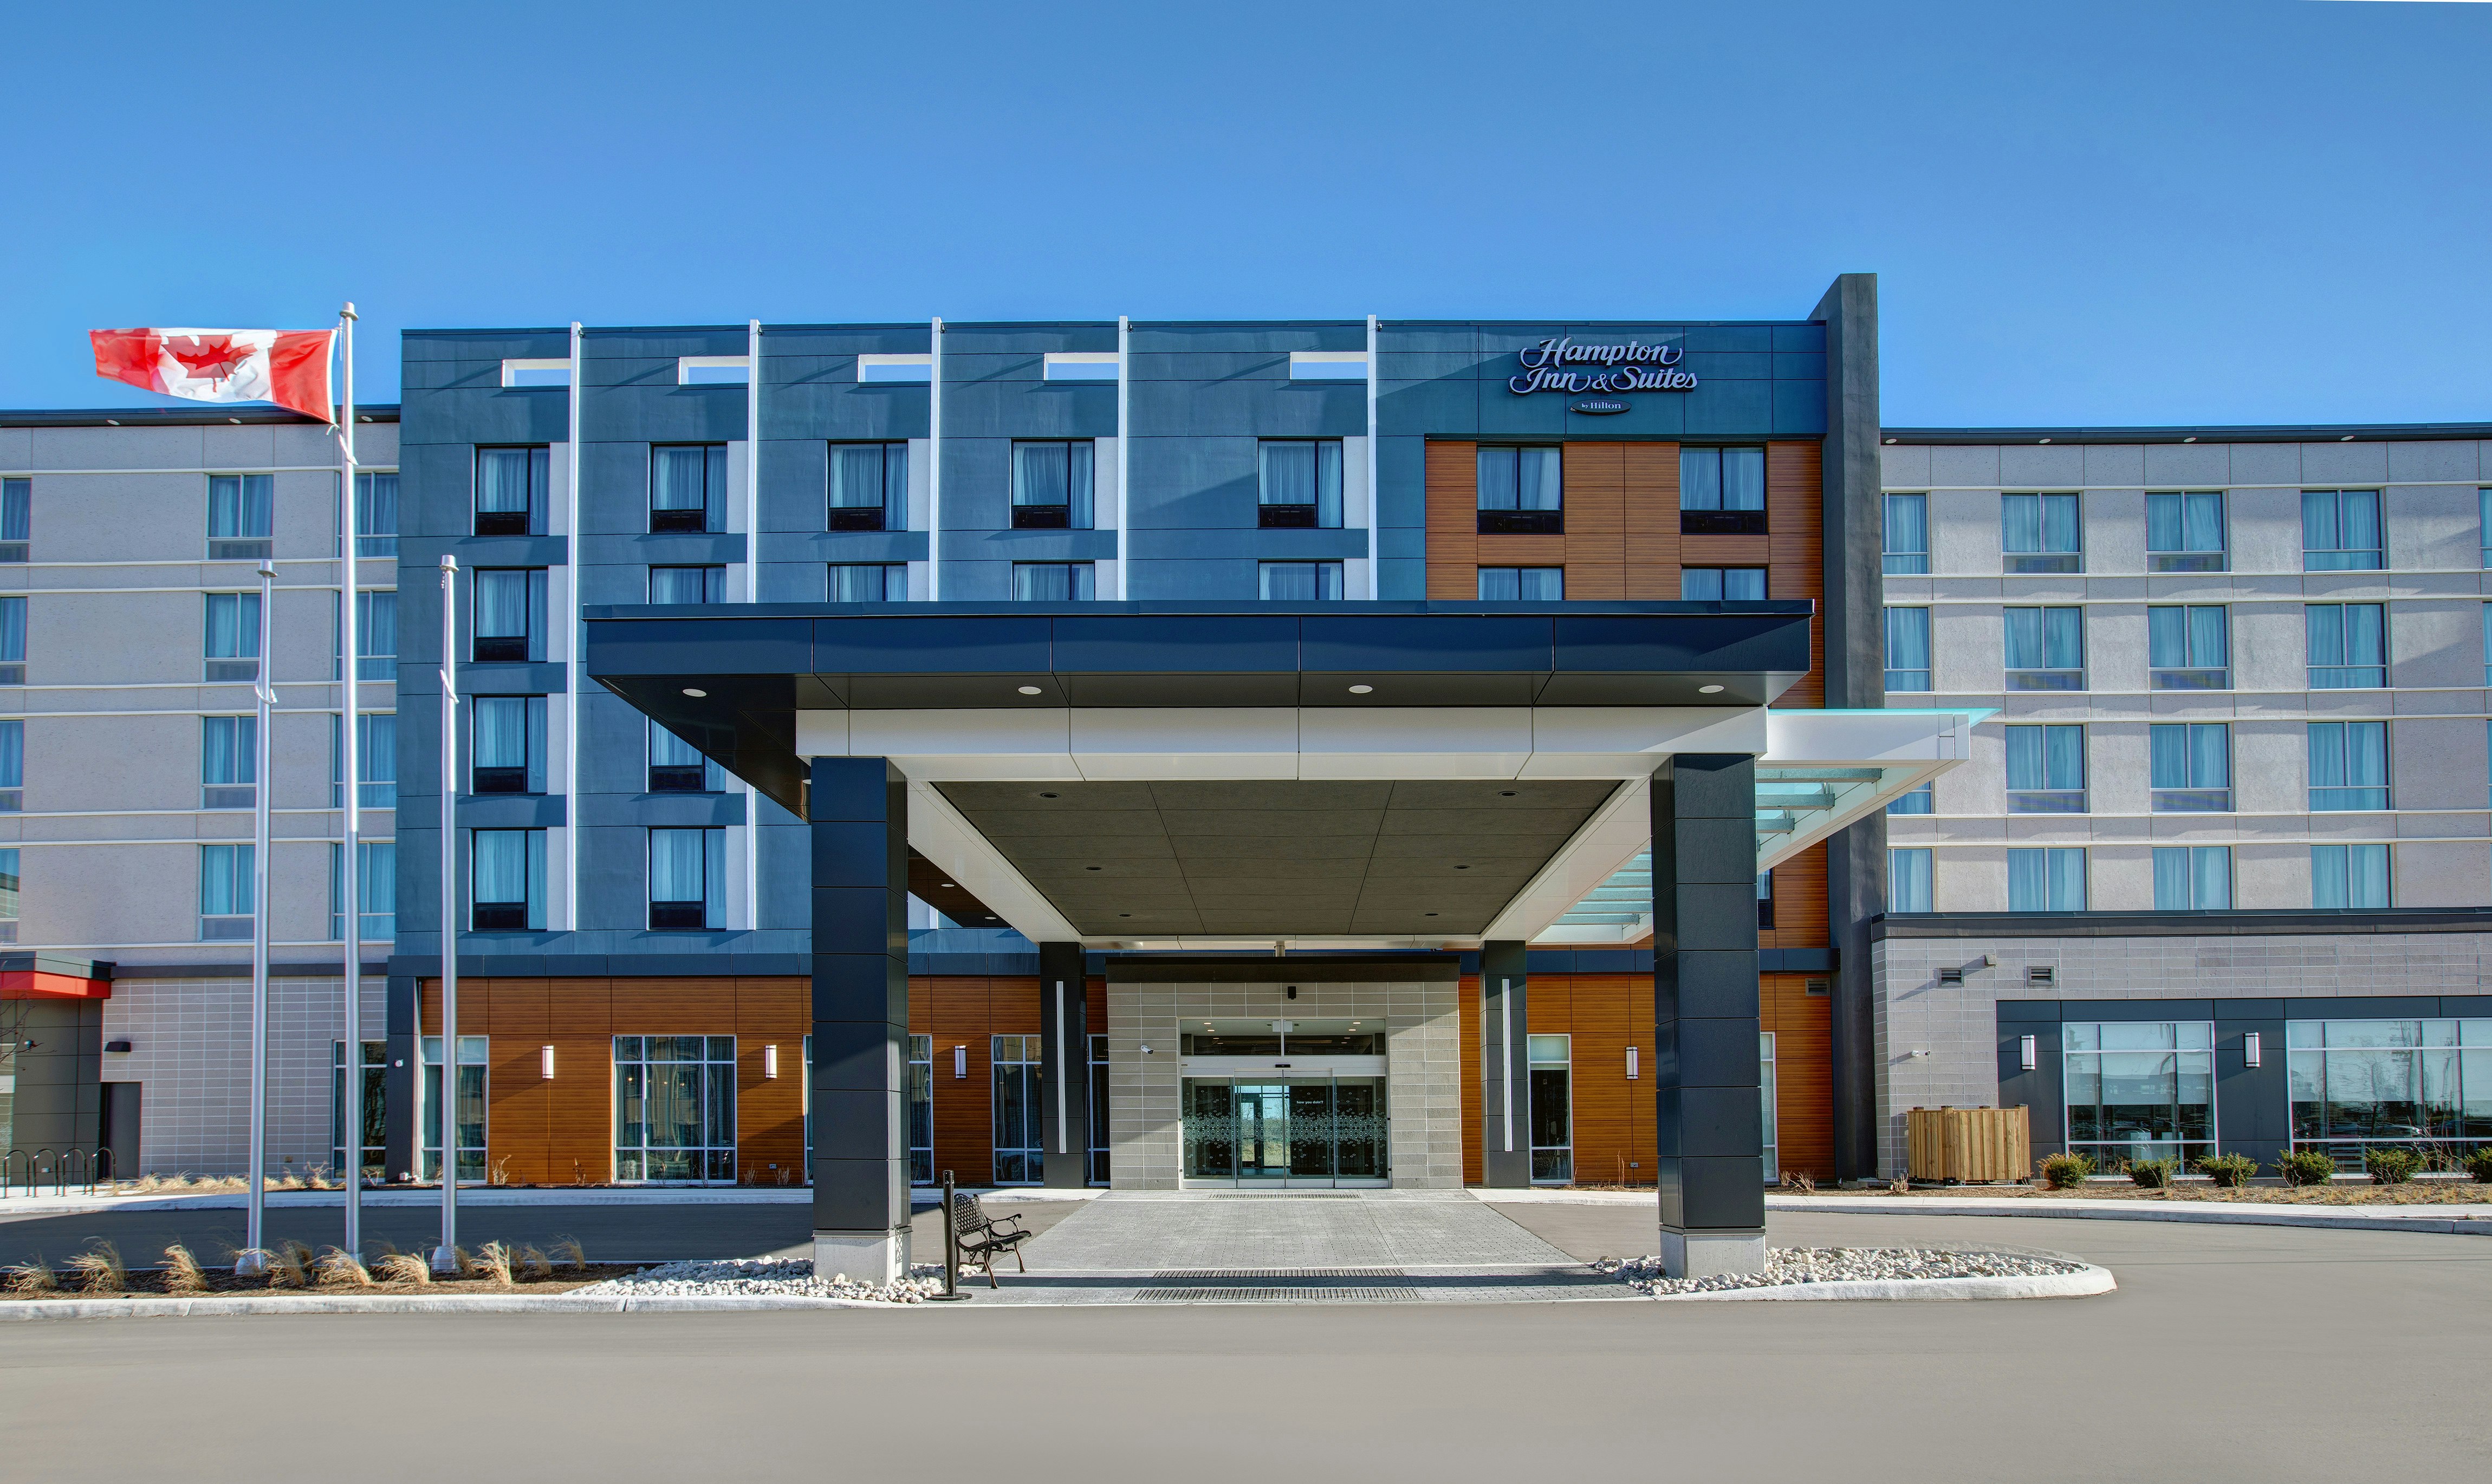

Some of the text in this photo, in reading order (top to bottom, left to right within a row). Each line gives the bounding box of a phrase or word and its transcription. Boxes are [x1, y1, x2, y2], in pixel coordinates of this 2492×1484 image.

[1520, 337, 1683, 368] Hampton
[1509, 366, 1698, 393] Inn & Suites
